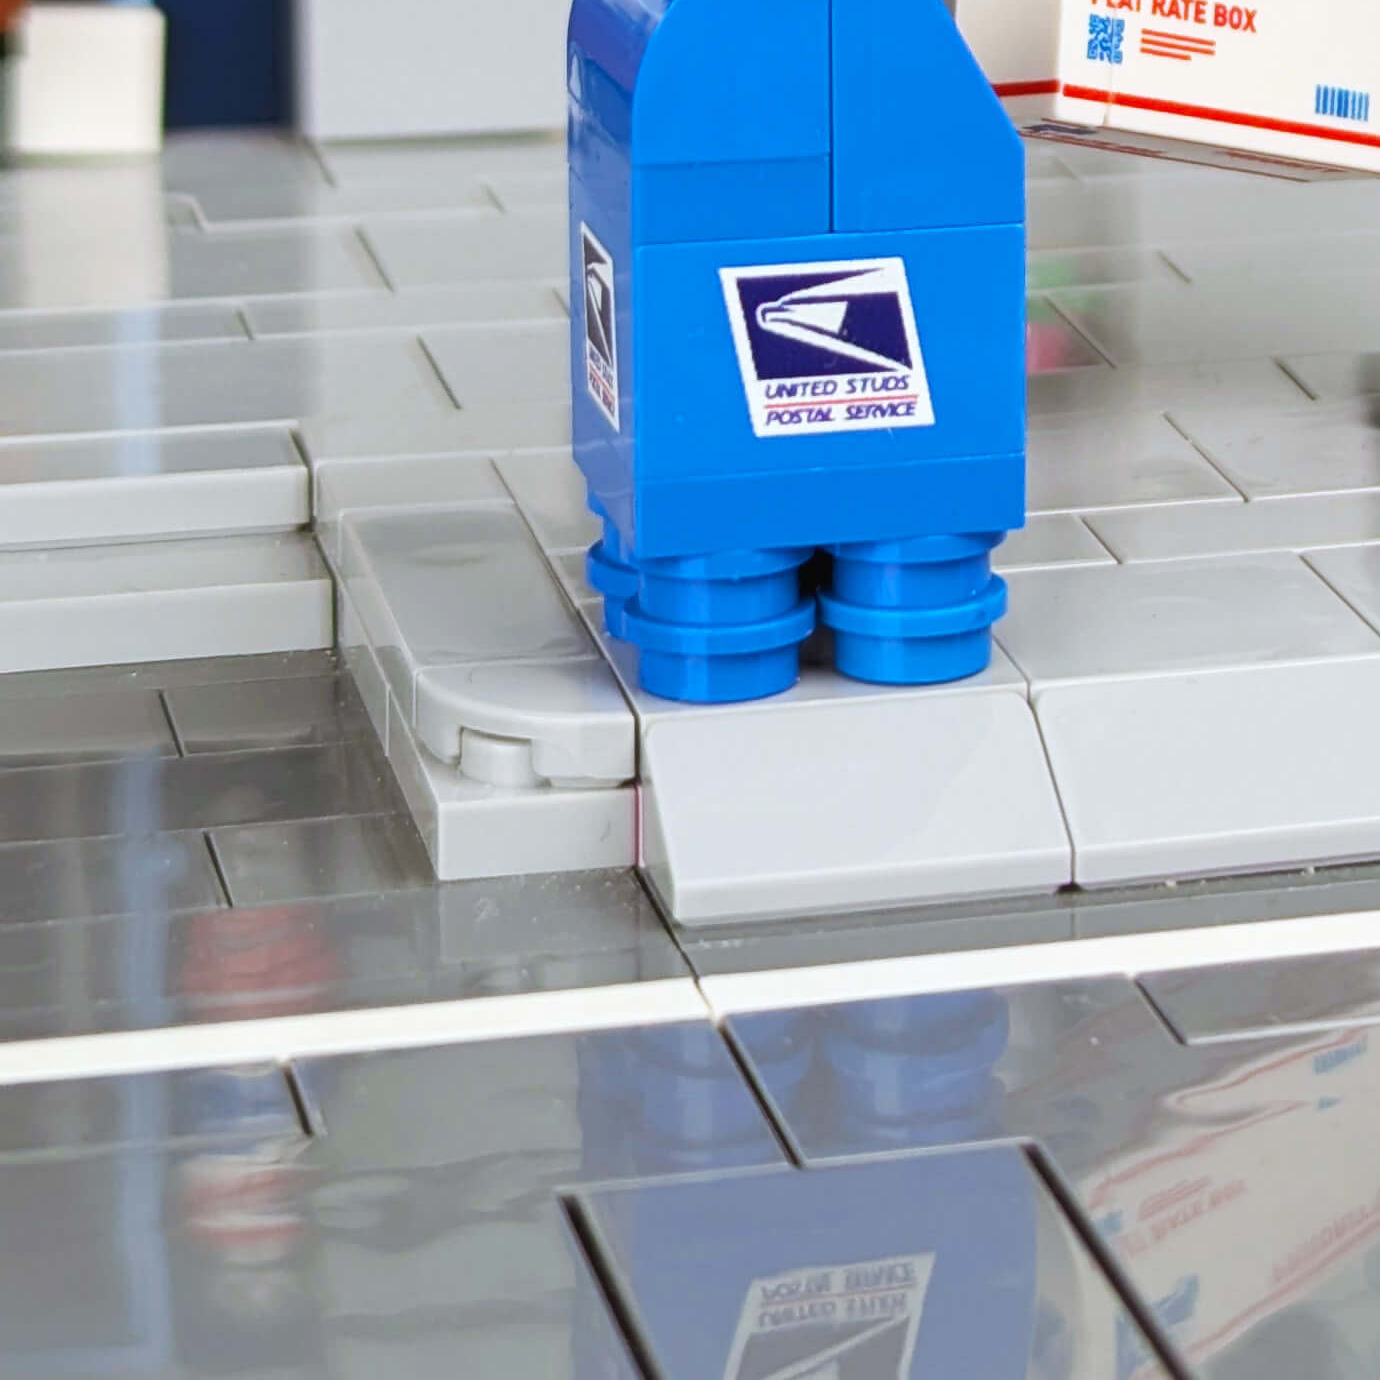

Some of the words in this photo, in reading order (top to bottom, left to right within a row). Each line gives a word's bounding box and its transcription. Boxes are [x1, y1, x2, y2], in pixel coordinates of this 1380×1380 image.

[1213, 3, 1258, 33] BOX
[764, 379, 838, 399] UNITED
[845, 374, 910, 394] STUDS
[765, 406, 836, 426] POSTAL
[844, 400, 917, 421] SERVICE
